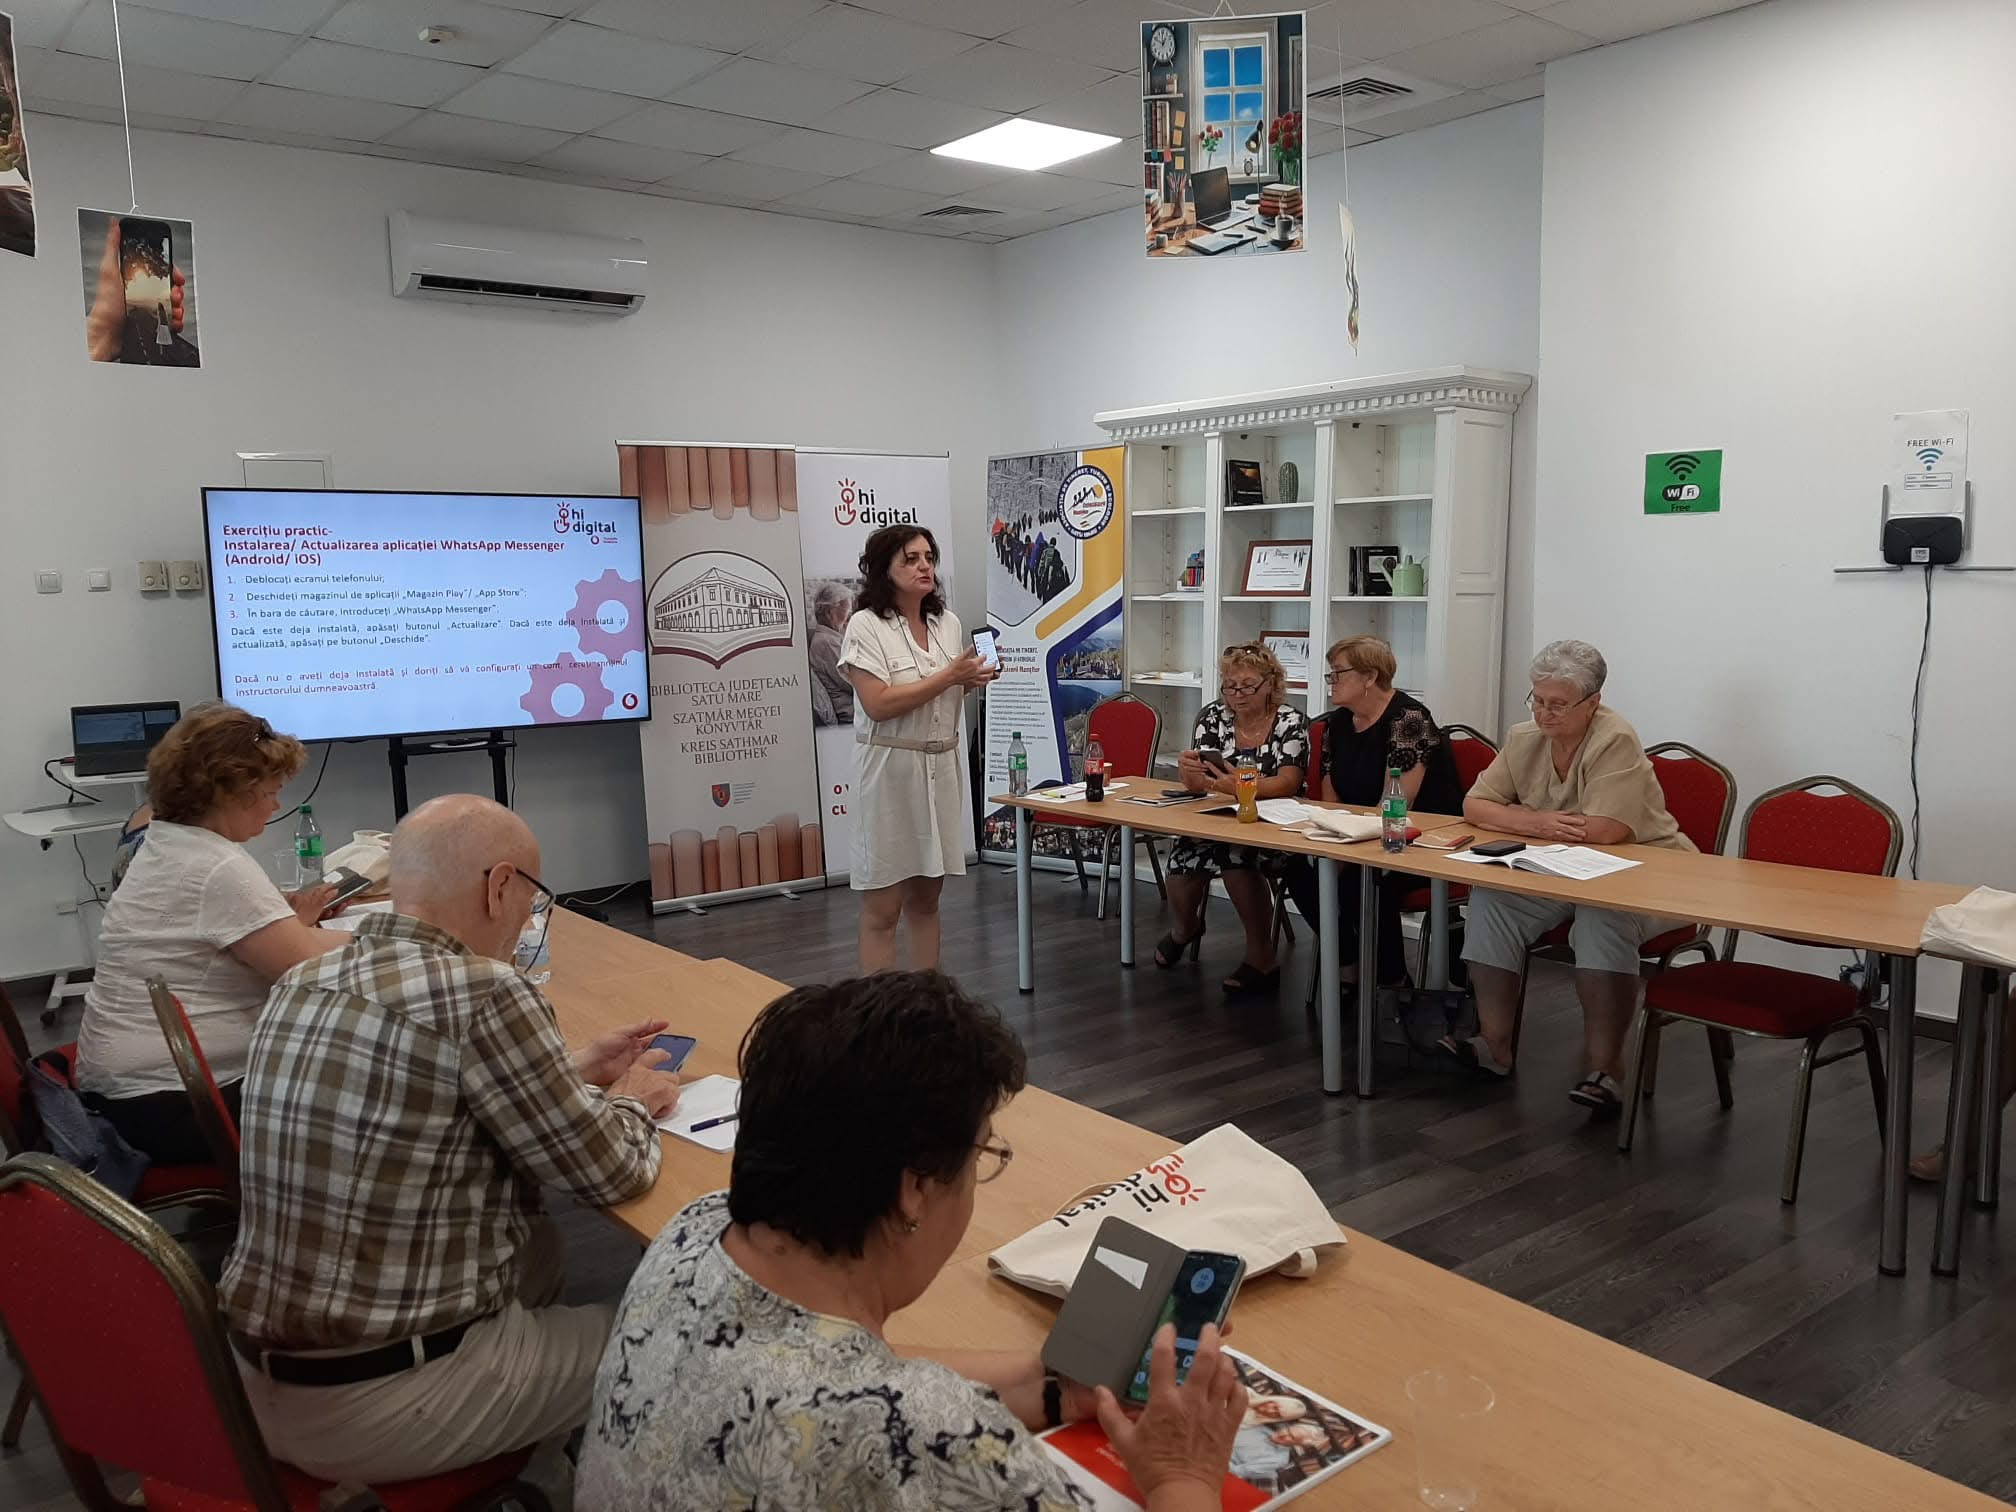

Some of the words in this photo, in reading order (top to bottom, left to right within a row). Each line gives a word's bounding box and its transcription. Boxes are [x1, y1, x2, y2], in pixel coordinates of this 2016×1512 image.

[858, 488, 875, 505] hi
[572, 508, 584, 520] hi
[1671, 504, 1690, 512] Free
[860, 507, 918, 528] digital
[223, 524, 280, 538] Exercițiu
[284, 525, 332, 538] practic-
[572, 520, 616, 535] digital
[224, 538, 296, 552] Instalarea/
[301, 540, 378, 550] Actualizarea
[382, 540, 437, 552] aplicației
[440, 540, 501, 552] WhatsApp
[504, 541, 564, 552] Messenger
[226, 554, 290, 566] (Android/
[295, 554, 321, 566] iOS)
[245, 575, 292, 585] Deblocați
[294, 574, 329, 584] ecranul
[246, 592, 298, 602] Deschideți
[300, 591, 348, 602] magazinul
[350, 591, 362, 600] de
[247, 608, 258, 618] În
[260, 608, 282, 618] bara
[284, 608, 296, 617] de
[340, 606, 390, 618] introduceți
[231, 627, 256, 636] Dacă
[262, 626, 282, 635] este
[290, 626, 310, 636] deja
[366, 623, 399, 633] apăsați
[406, 622, 440, 630] butonul
[510, 619, 530, 628] Dacă
[558, 618, 576, 628] deja
[581, 618, 614, 626] instalată
[232, 639, 288, 650] actualizată,
[290, 638, 324, 648] apăsați
[327, 640, 338, 649] pe
[341, 636, 376, 646] butonul
[235, 674, 259, 684] Dacă
[300, 672, 322, 682] aveți
[330, 671, 350, 680] deja
[356, 668, 395, 678] instalată
[444, 666, 454, 674] să
[236, 684, 301, 697] instructorului
[651, 682, 726, 697] BIBLIOTECA
[691, 693, 725, 706] SATU
[728, 690, 763, 704] MARE
[672, 707, 734, 725] SZATMÁR
[736, 706, 782, 720] MEGYEI
[680, 740, 717, 754] KREIS
[720, 734, 779, 750] SATHMAR
[694, 746, 768, 765] BIBLIOTHEK
[1132, 1183, 1170, 1212] hi
